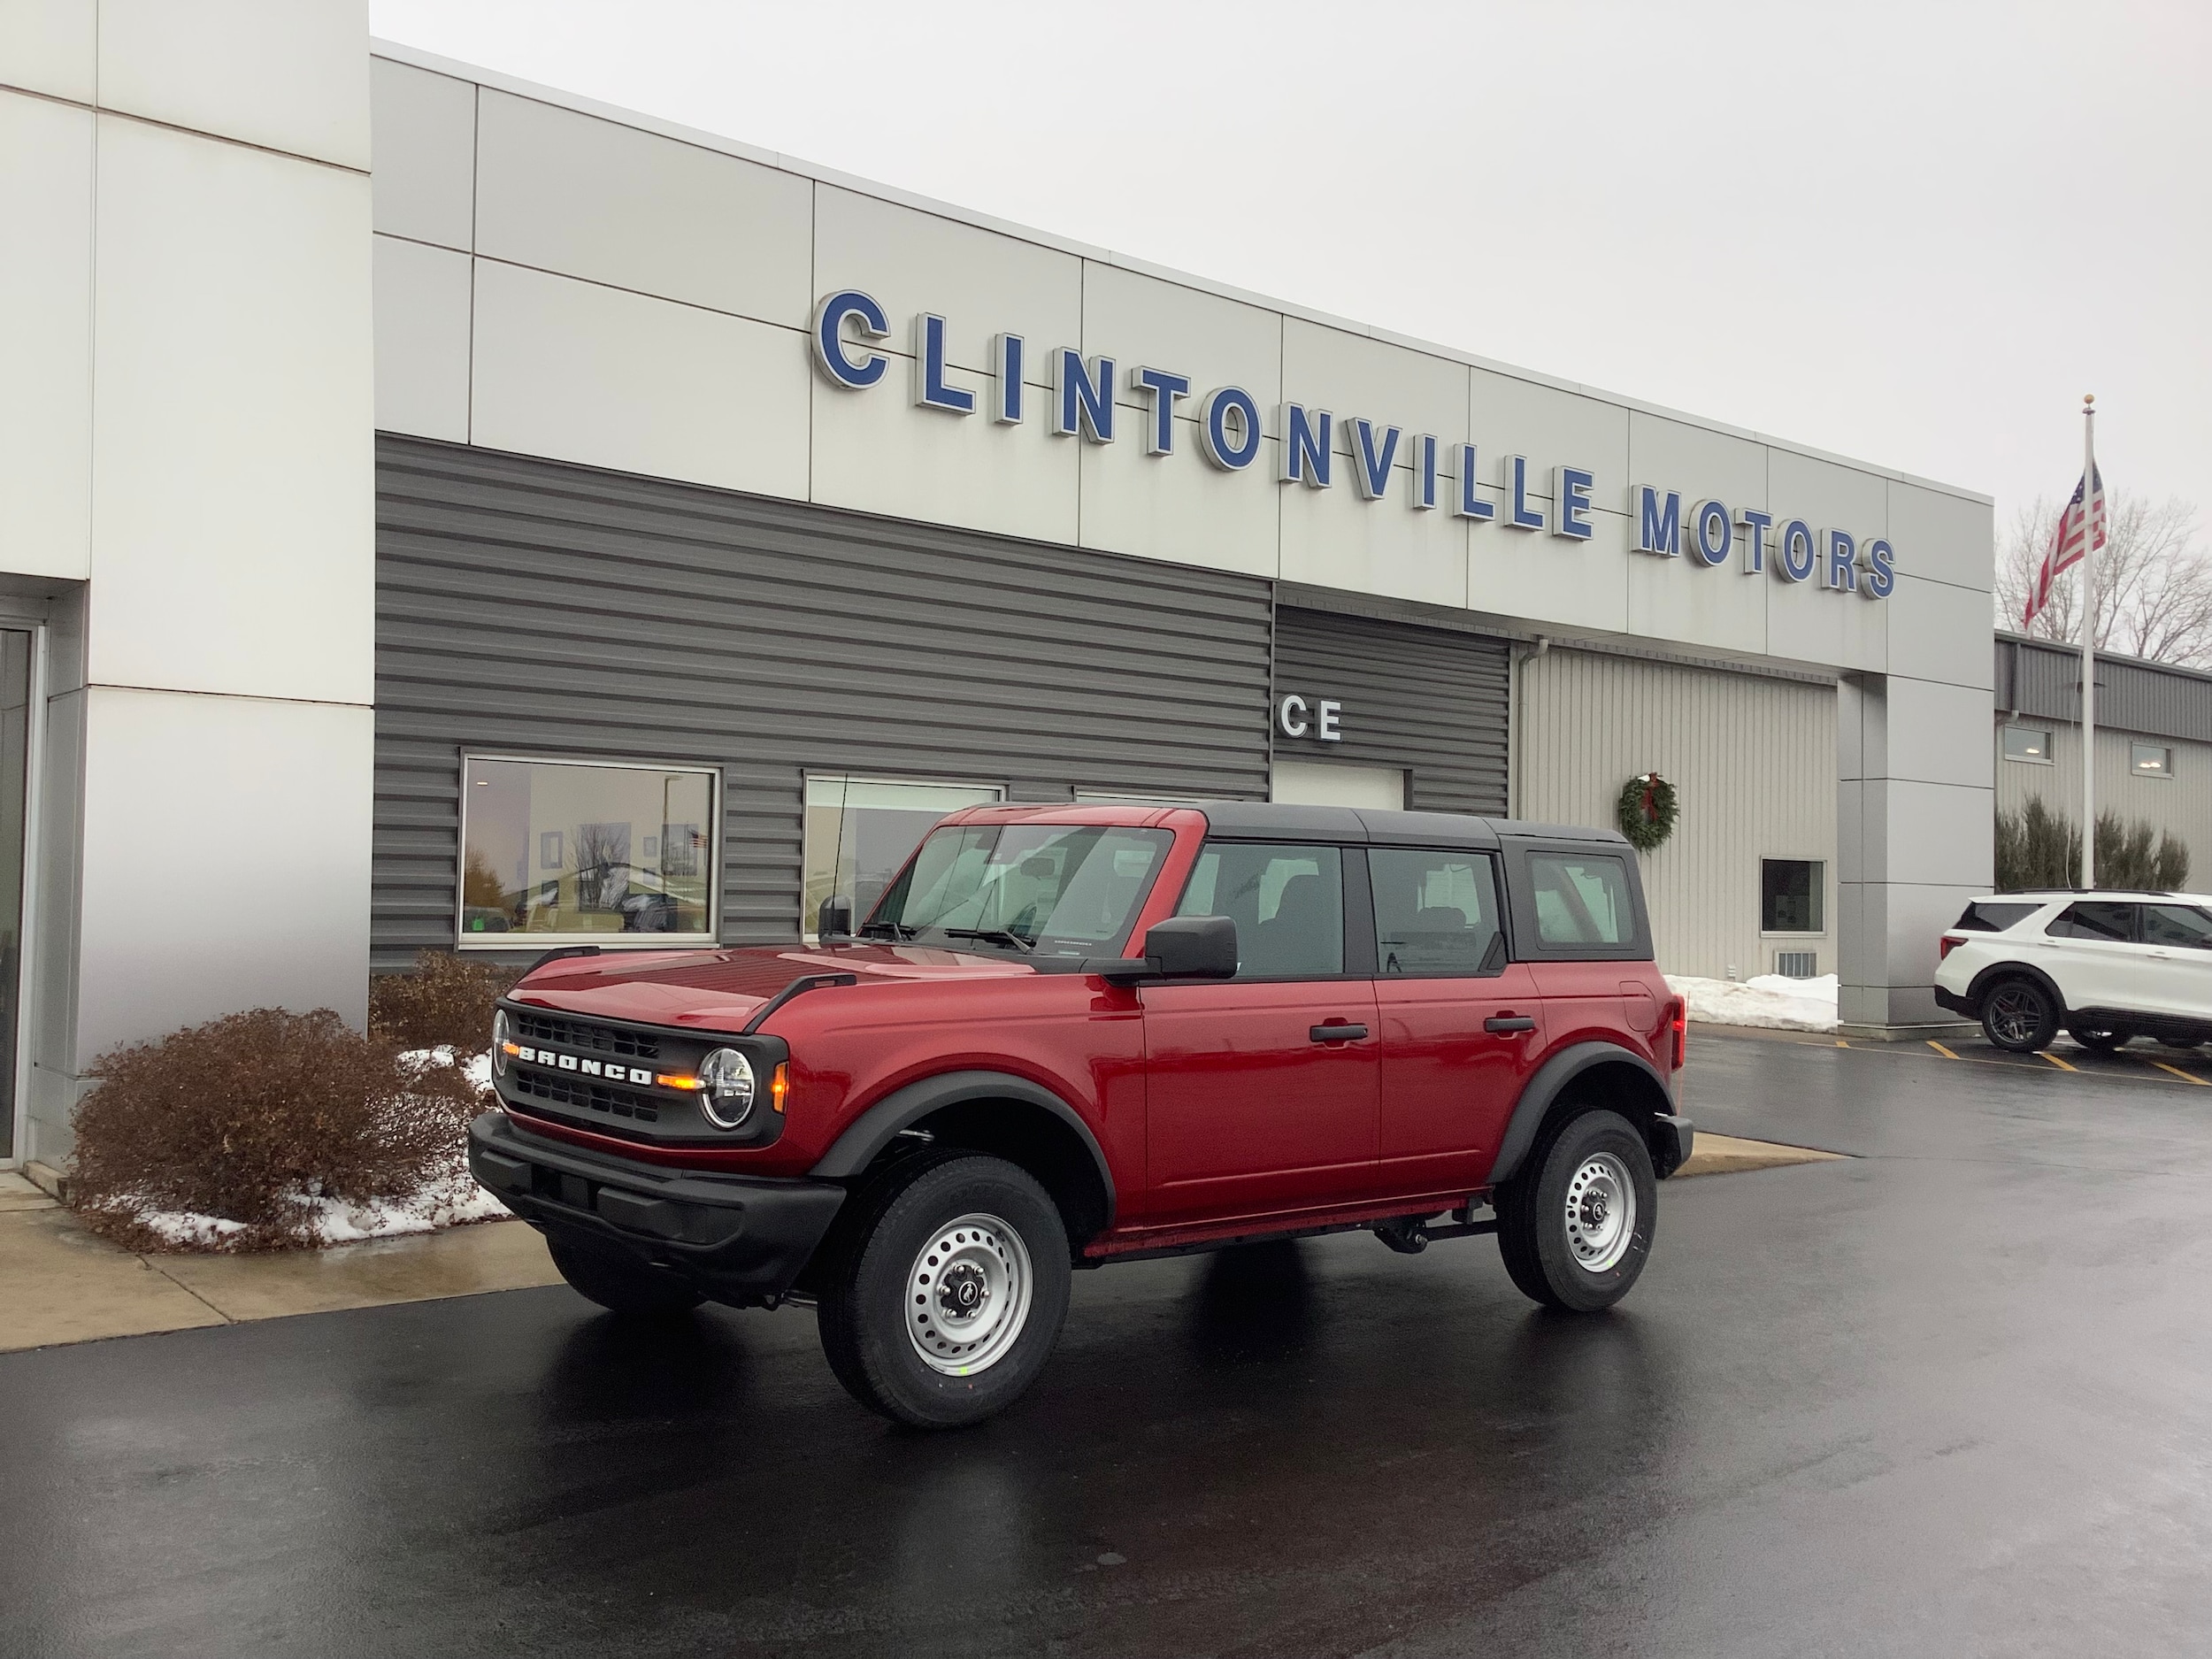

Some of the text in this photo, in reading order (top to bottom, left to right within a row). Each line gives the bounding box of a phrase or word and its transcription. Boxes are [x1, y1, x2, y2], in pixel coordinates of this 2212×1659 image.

[812, 289, 1896, 600] CLINTONVILLE MOTORS
[518, 1046, 652, 1085] BRONCO
